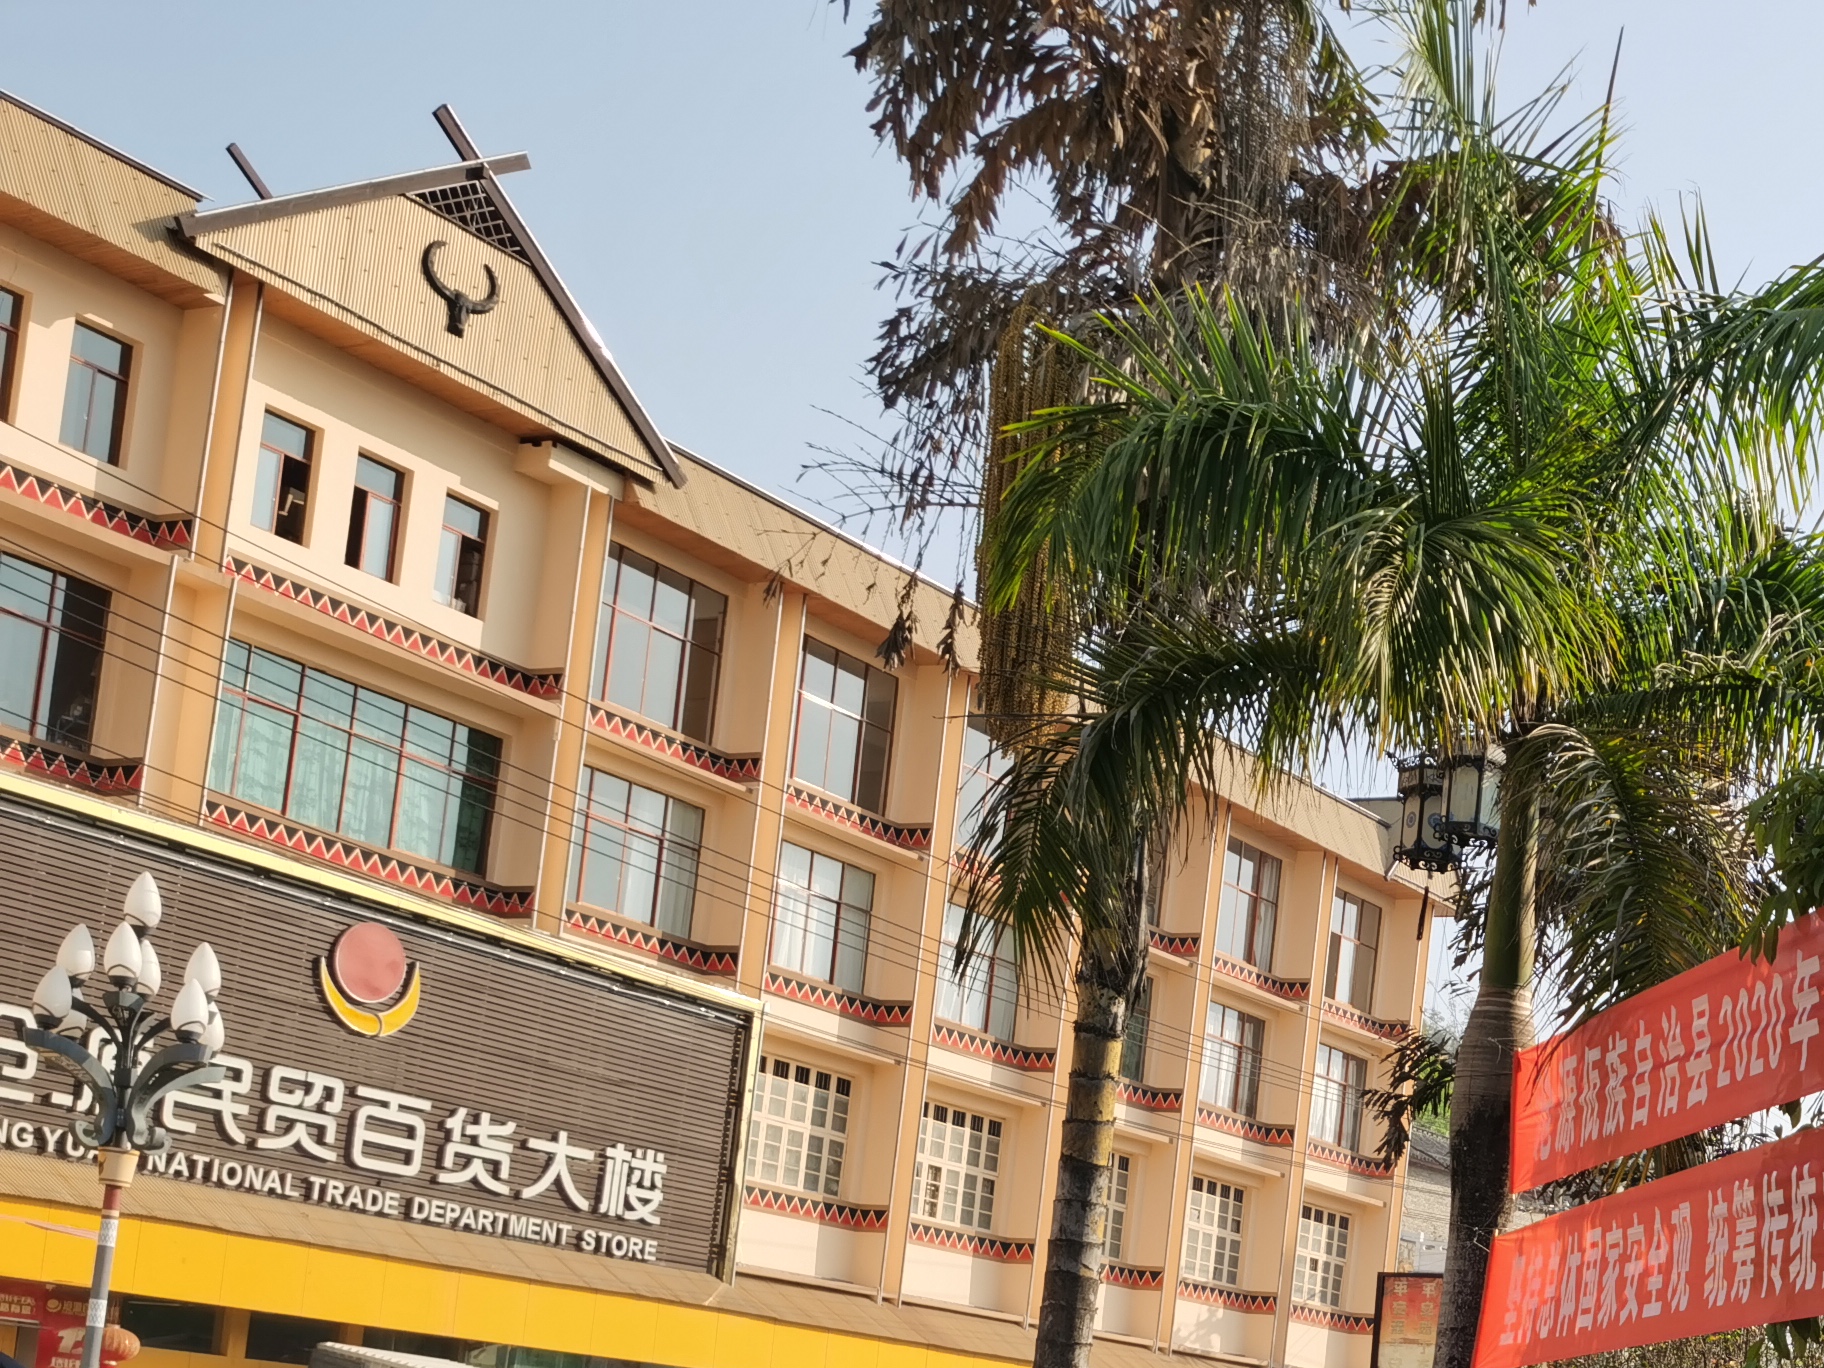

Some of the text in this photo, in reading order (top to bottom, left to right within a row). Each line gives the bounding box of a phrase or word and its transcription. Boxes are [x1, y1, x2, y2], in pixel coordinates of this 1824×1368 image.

[147, 1151, 300, 1197] NATIONAL
[309, 1176, 401, 1215] TRADE
[411, 1197, 573, 1245] DEPARTMENT
[581, 1229, 659, 1261] STORE
